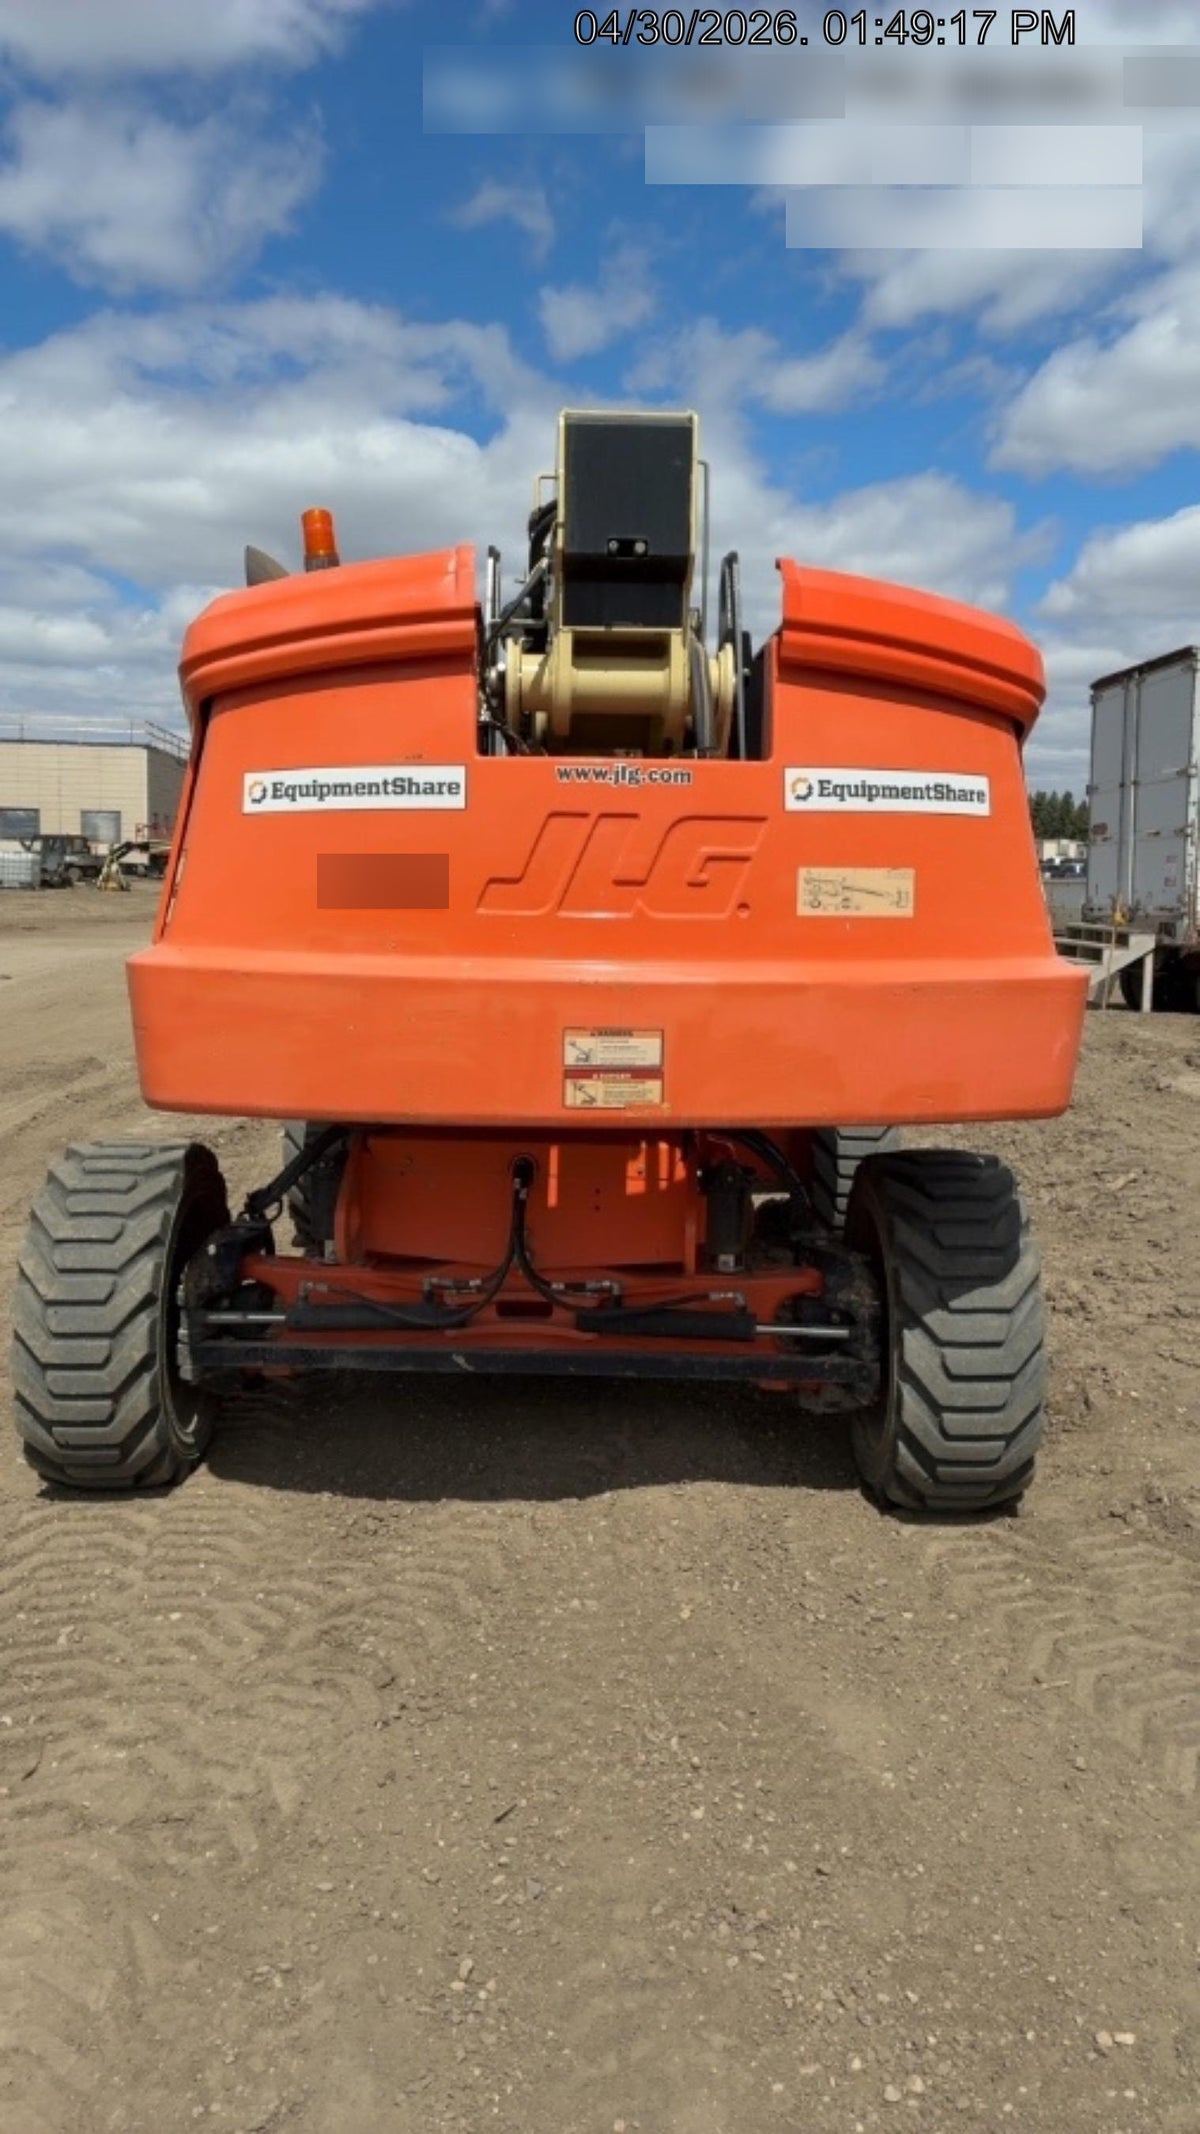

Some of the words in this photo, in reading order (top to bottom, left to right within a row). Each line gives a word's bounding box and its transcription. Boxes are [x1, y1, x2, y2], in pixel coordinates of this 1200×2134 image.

[556, 764, 692, 785] www.jlg.com
[270, 777, 461, 802] EquipmentShare
[817, 779, 986, 804] EquipmentShare
